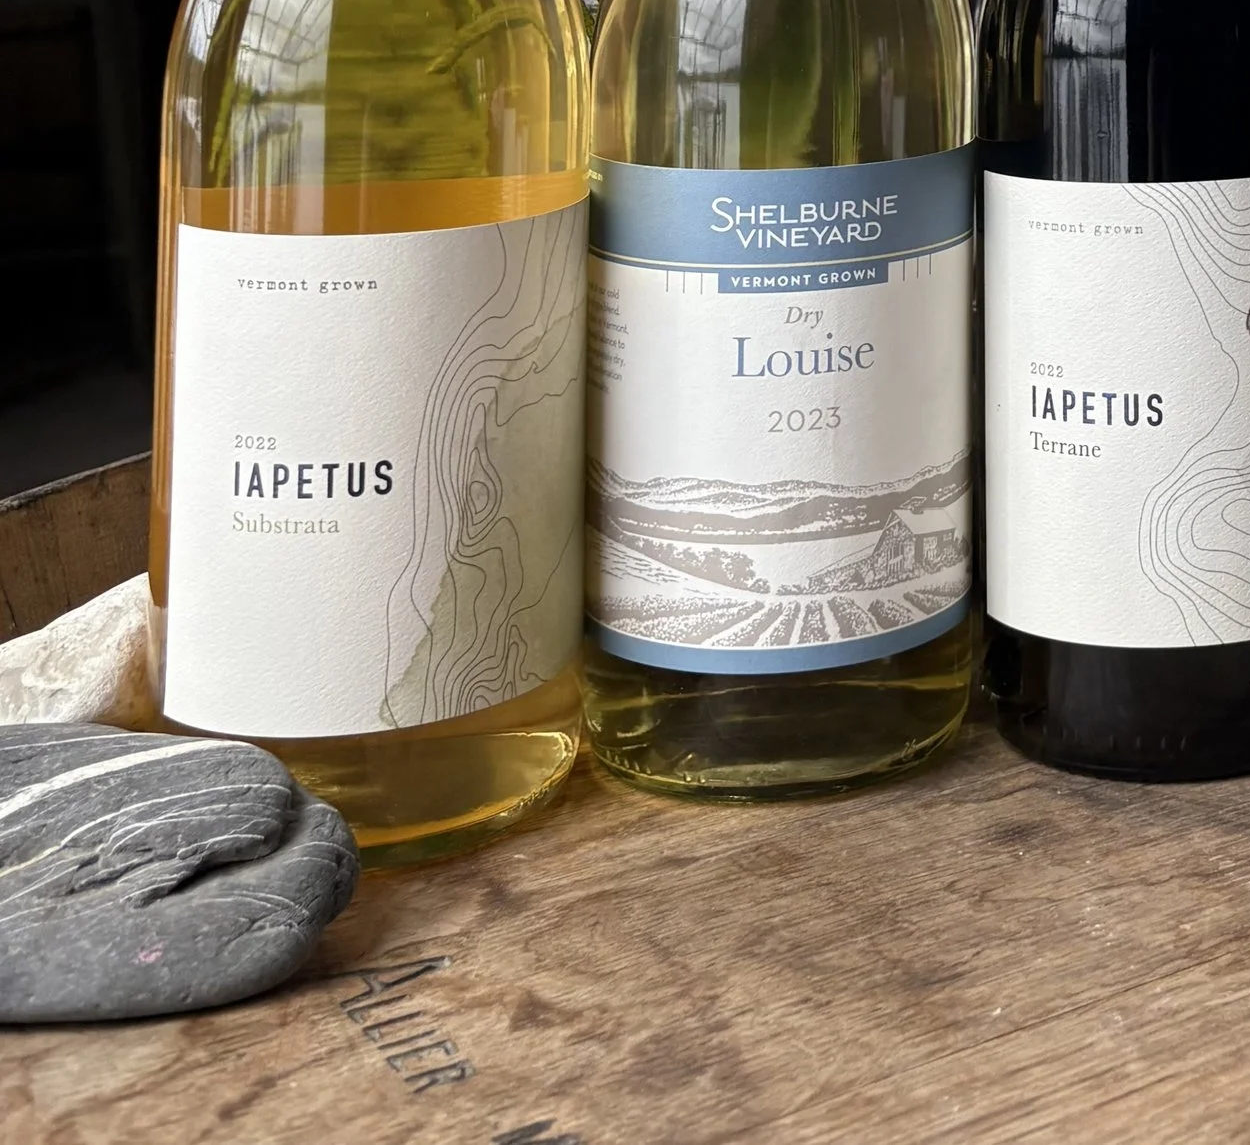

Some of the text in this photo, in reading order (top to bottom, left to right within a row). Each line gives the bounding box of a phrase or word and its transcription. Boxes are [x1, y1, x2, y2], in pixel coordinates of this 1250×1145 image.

[710, 195, 898, 233] SHELBURNE
[736, 221, 882, 249] VINEYARD
[1028, 219, 1144, 237] vermont grown
[237, 277, 379, 294] vermont grown
[731, 268, 877, 288] VERMONT GROWN
[784, 306, 824, 329] Dry
[731, 332, 875, 378] Louise
[1029, 362, 1065, 378] 2022
[1031, 385, 1165, 427] IAPETUS
[767, 407, 842, 433] 2023
[234, 435, 277, 451] 2022
[1029, 431, 1101, 458] Terrane
[233, 459, 394, 499] IAPETUS
[232, 511, 341, 536] Substrata
